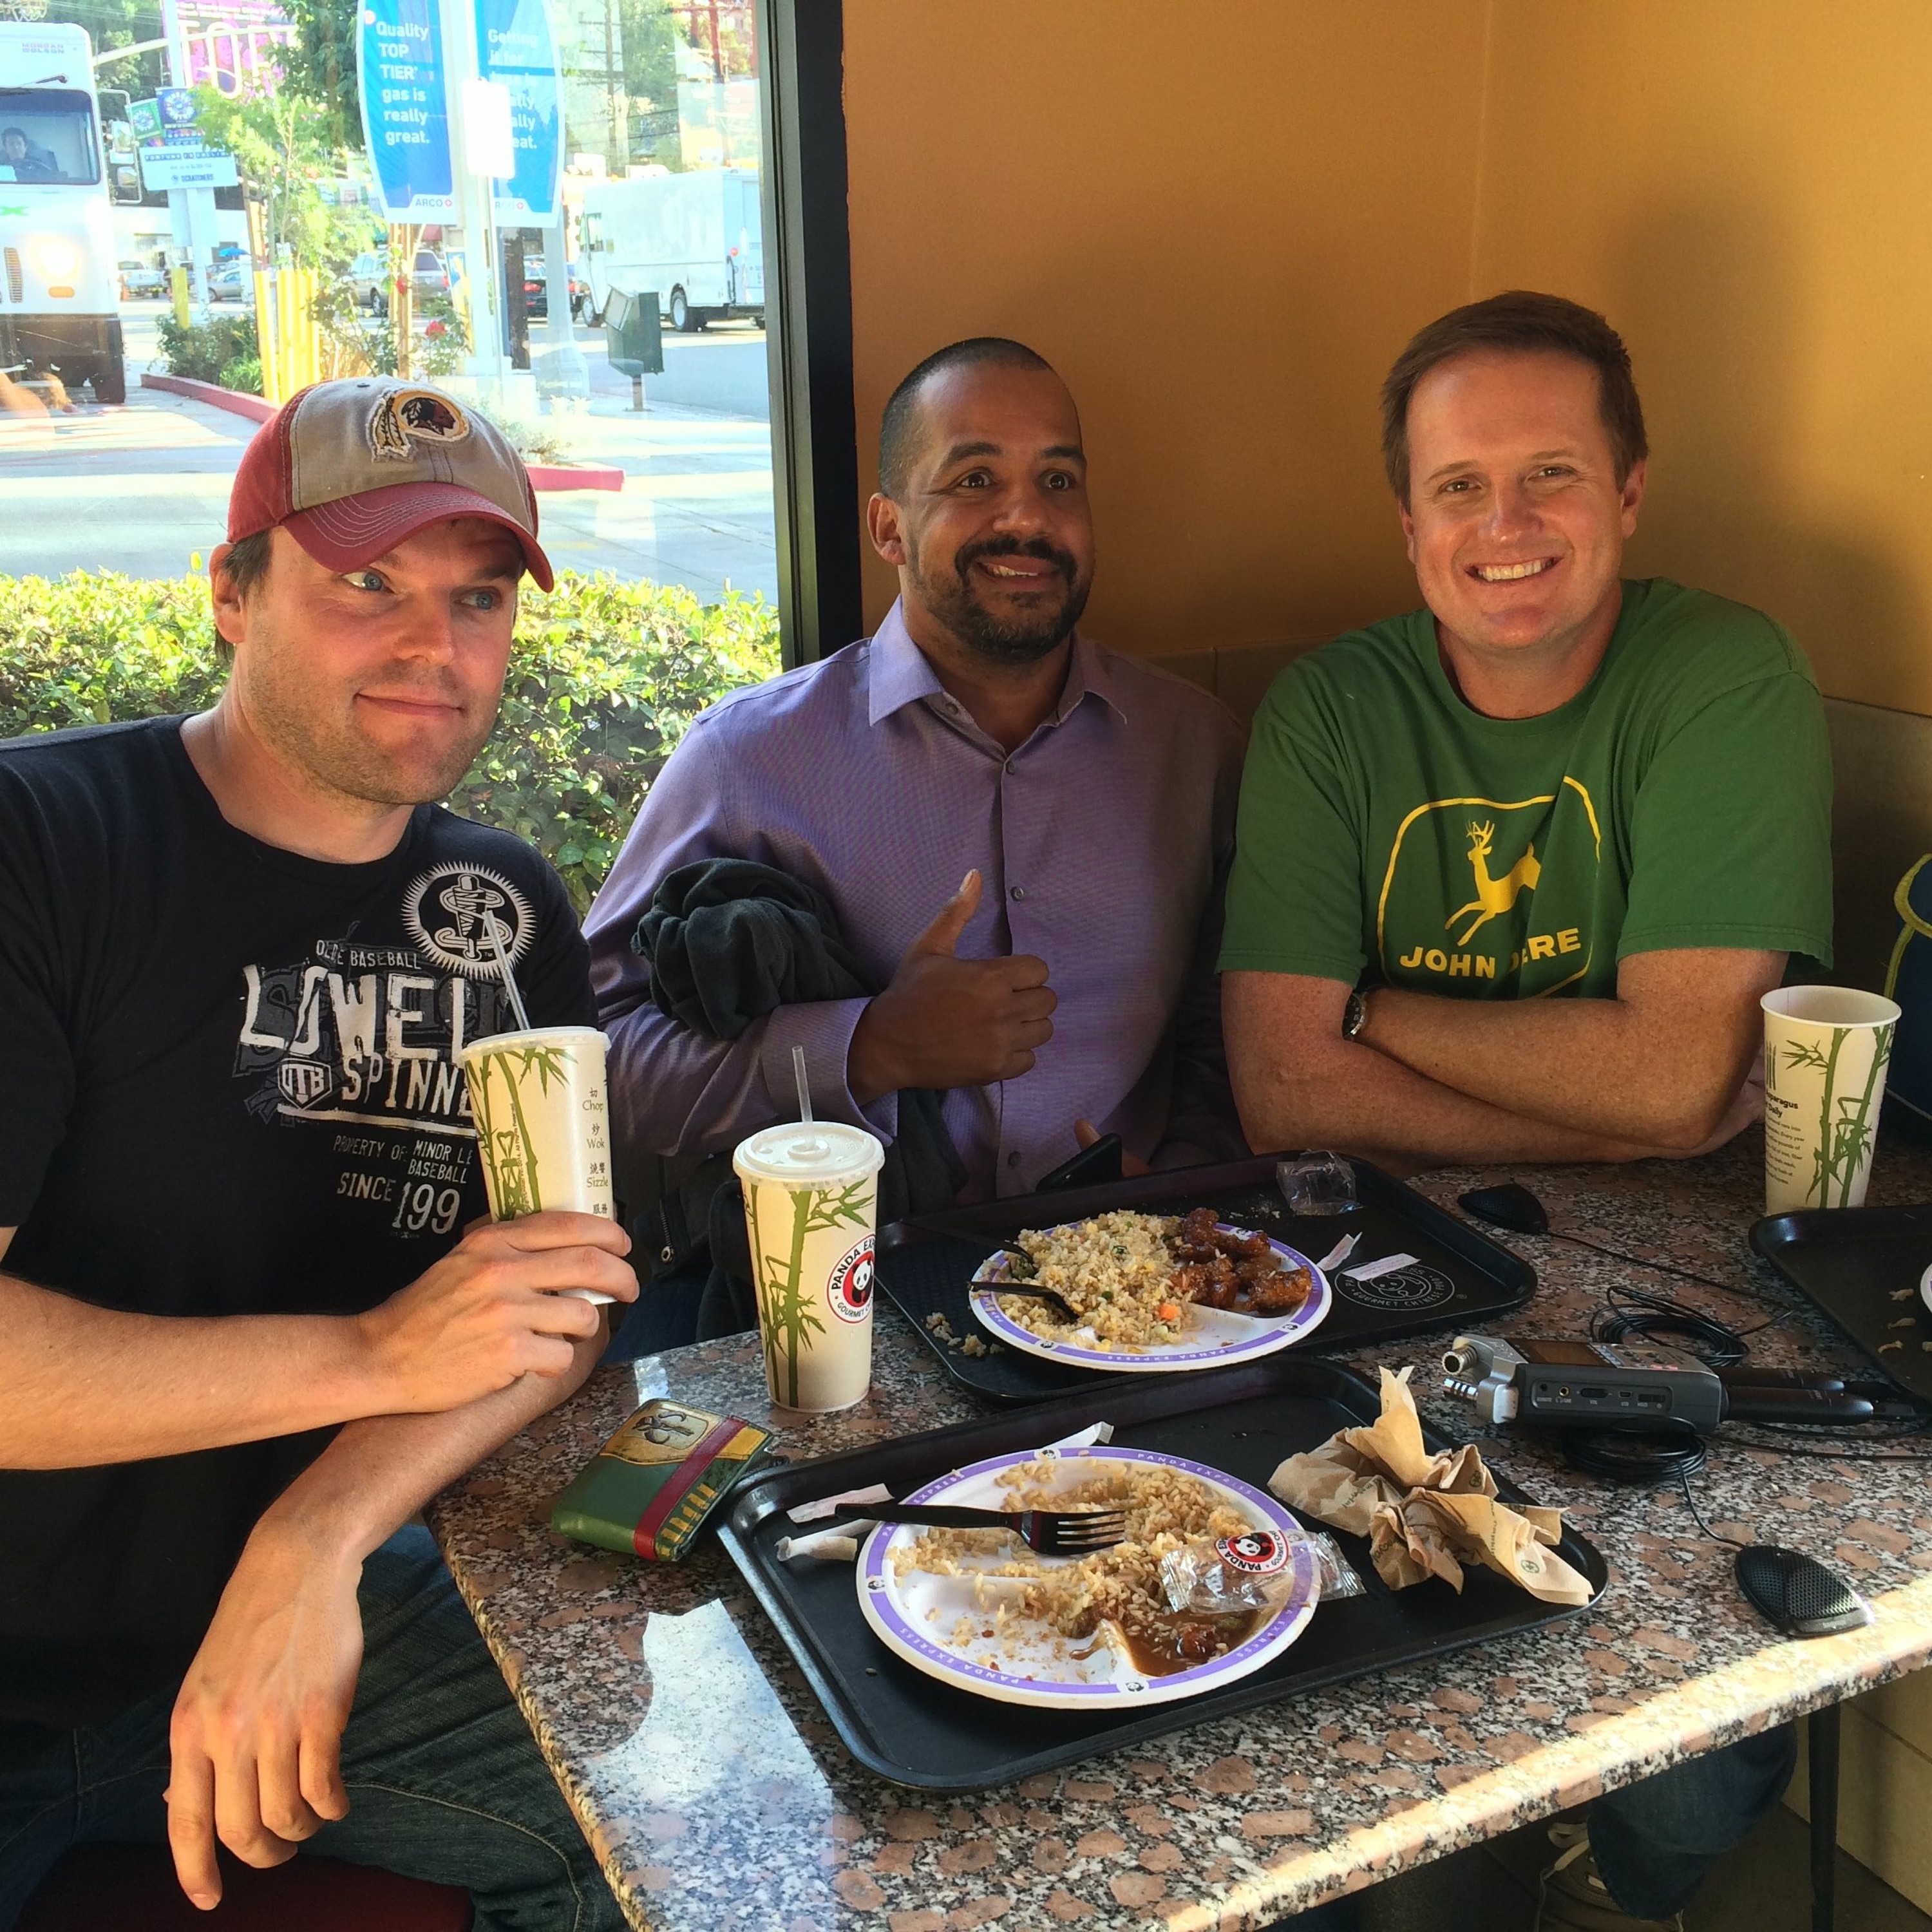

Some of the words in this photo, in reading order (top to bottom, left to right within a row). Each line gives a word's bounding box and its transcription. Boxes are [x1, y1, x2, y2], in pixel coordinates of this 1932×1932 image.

[376, 21, 428, 41] Quality
[378, 43, 409, 57] TOP
[382, 89, 410, 104] gas
[413, 88, 426, 101] is
[384, 108, 428, 126] really
[511, 113, 536, 131] ally
[385, 131, 430, 146] great.
[513, 135, 537, 149] eat.
[415, 198, 443, 207] ARCO
[495, 201, 515, 210] RCO
[316, 939, 344, 965] OLDE
[350, 950, 422, 970] BASEBALL
[1399, 945, 1497, 980] JOHN
[582, 1099, 604, 1113] Chop
[333, 1135, 386, 1158] PROPERTY
[413, 1139, 452, 1161] MINOR
[587, 1137, 605, 1150] Wok
[408, 1159, 468, 1184] BASEBALL
[337, 1171, 397, 1202] SINCE
[587, 1176, 609, 1188] Sizzle
[831, 1247, 861, 1290] PANDA
[837, 1302, 864, 1318] GOURMET
[1137, 1453, 1187, 1468] PANDA
[1196, 1466, 1253, 1495] EXPRESS
[1224, 1550, 1262, 1571] PANDA
[899, 1627, 954, 1663] EXPRESS
[962, 1663, 1019, 1684] PANDA
